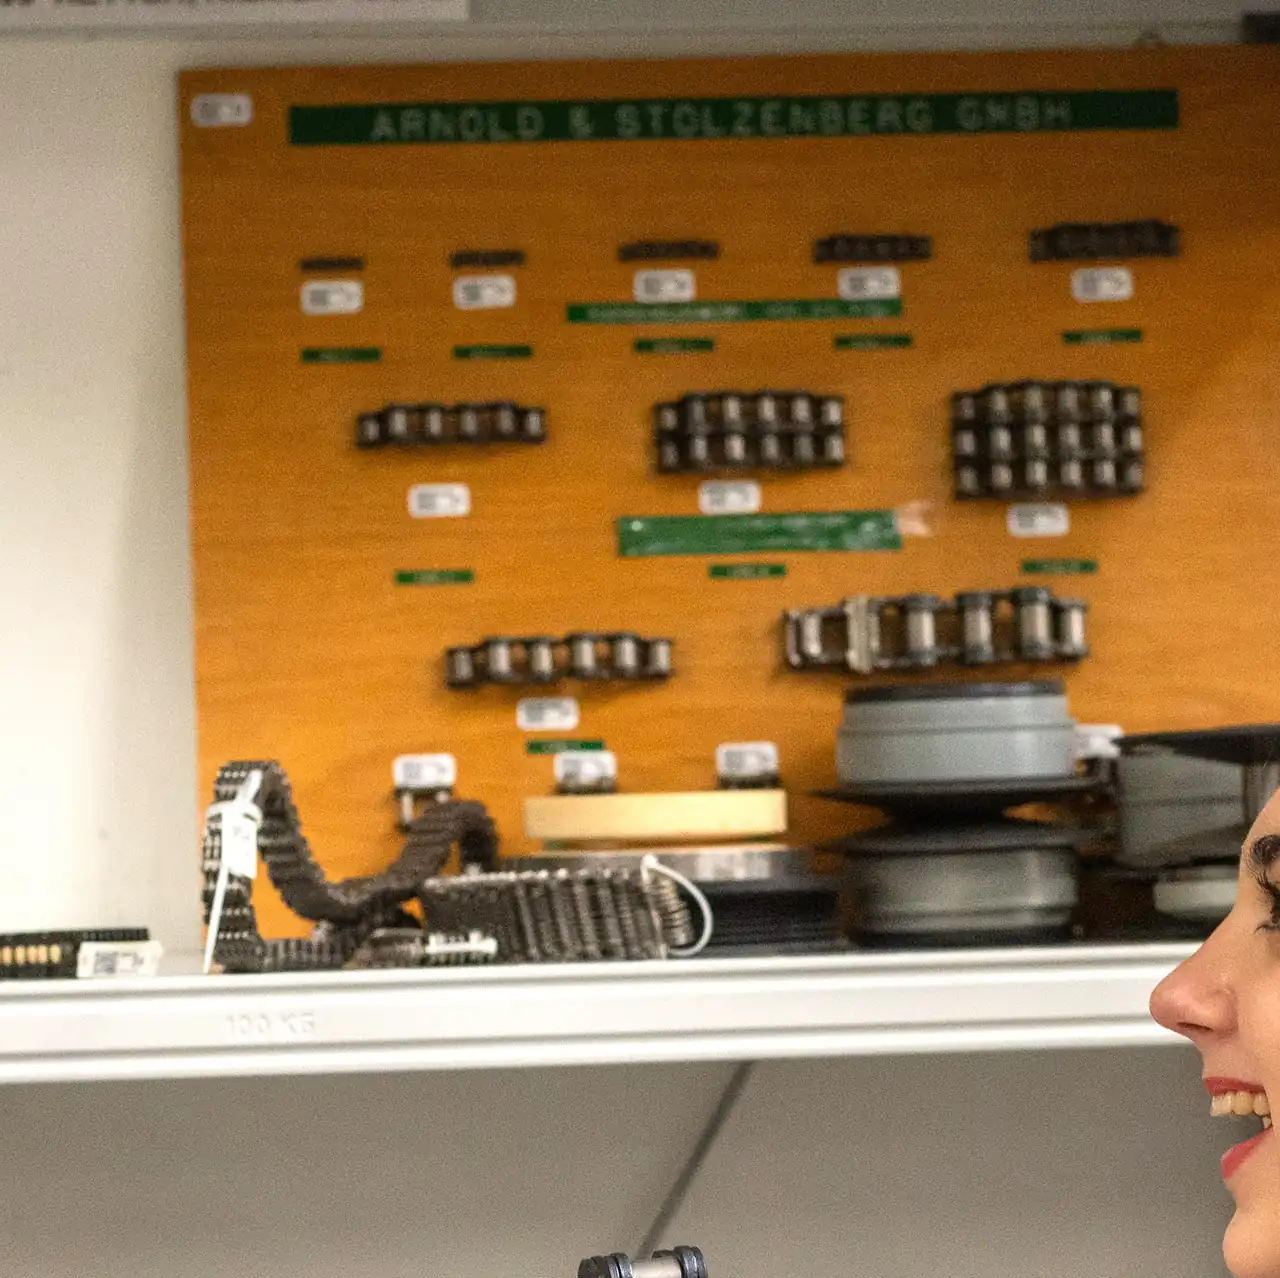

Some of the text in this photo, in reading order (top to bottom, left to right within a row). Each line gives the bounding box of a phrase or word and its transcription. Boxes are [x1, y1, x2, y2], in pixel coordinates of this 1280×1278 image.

[369, 97, 1072, 141] ARNOLD & STOLZENBERG GMBH
